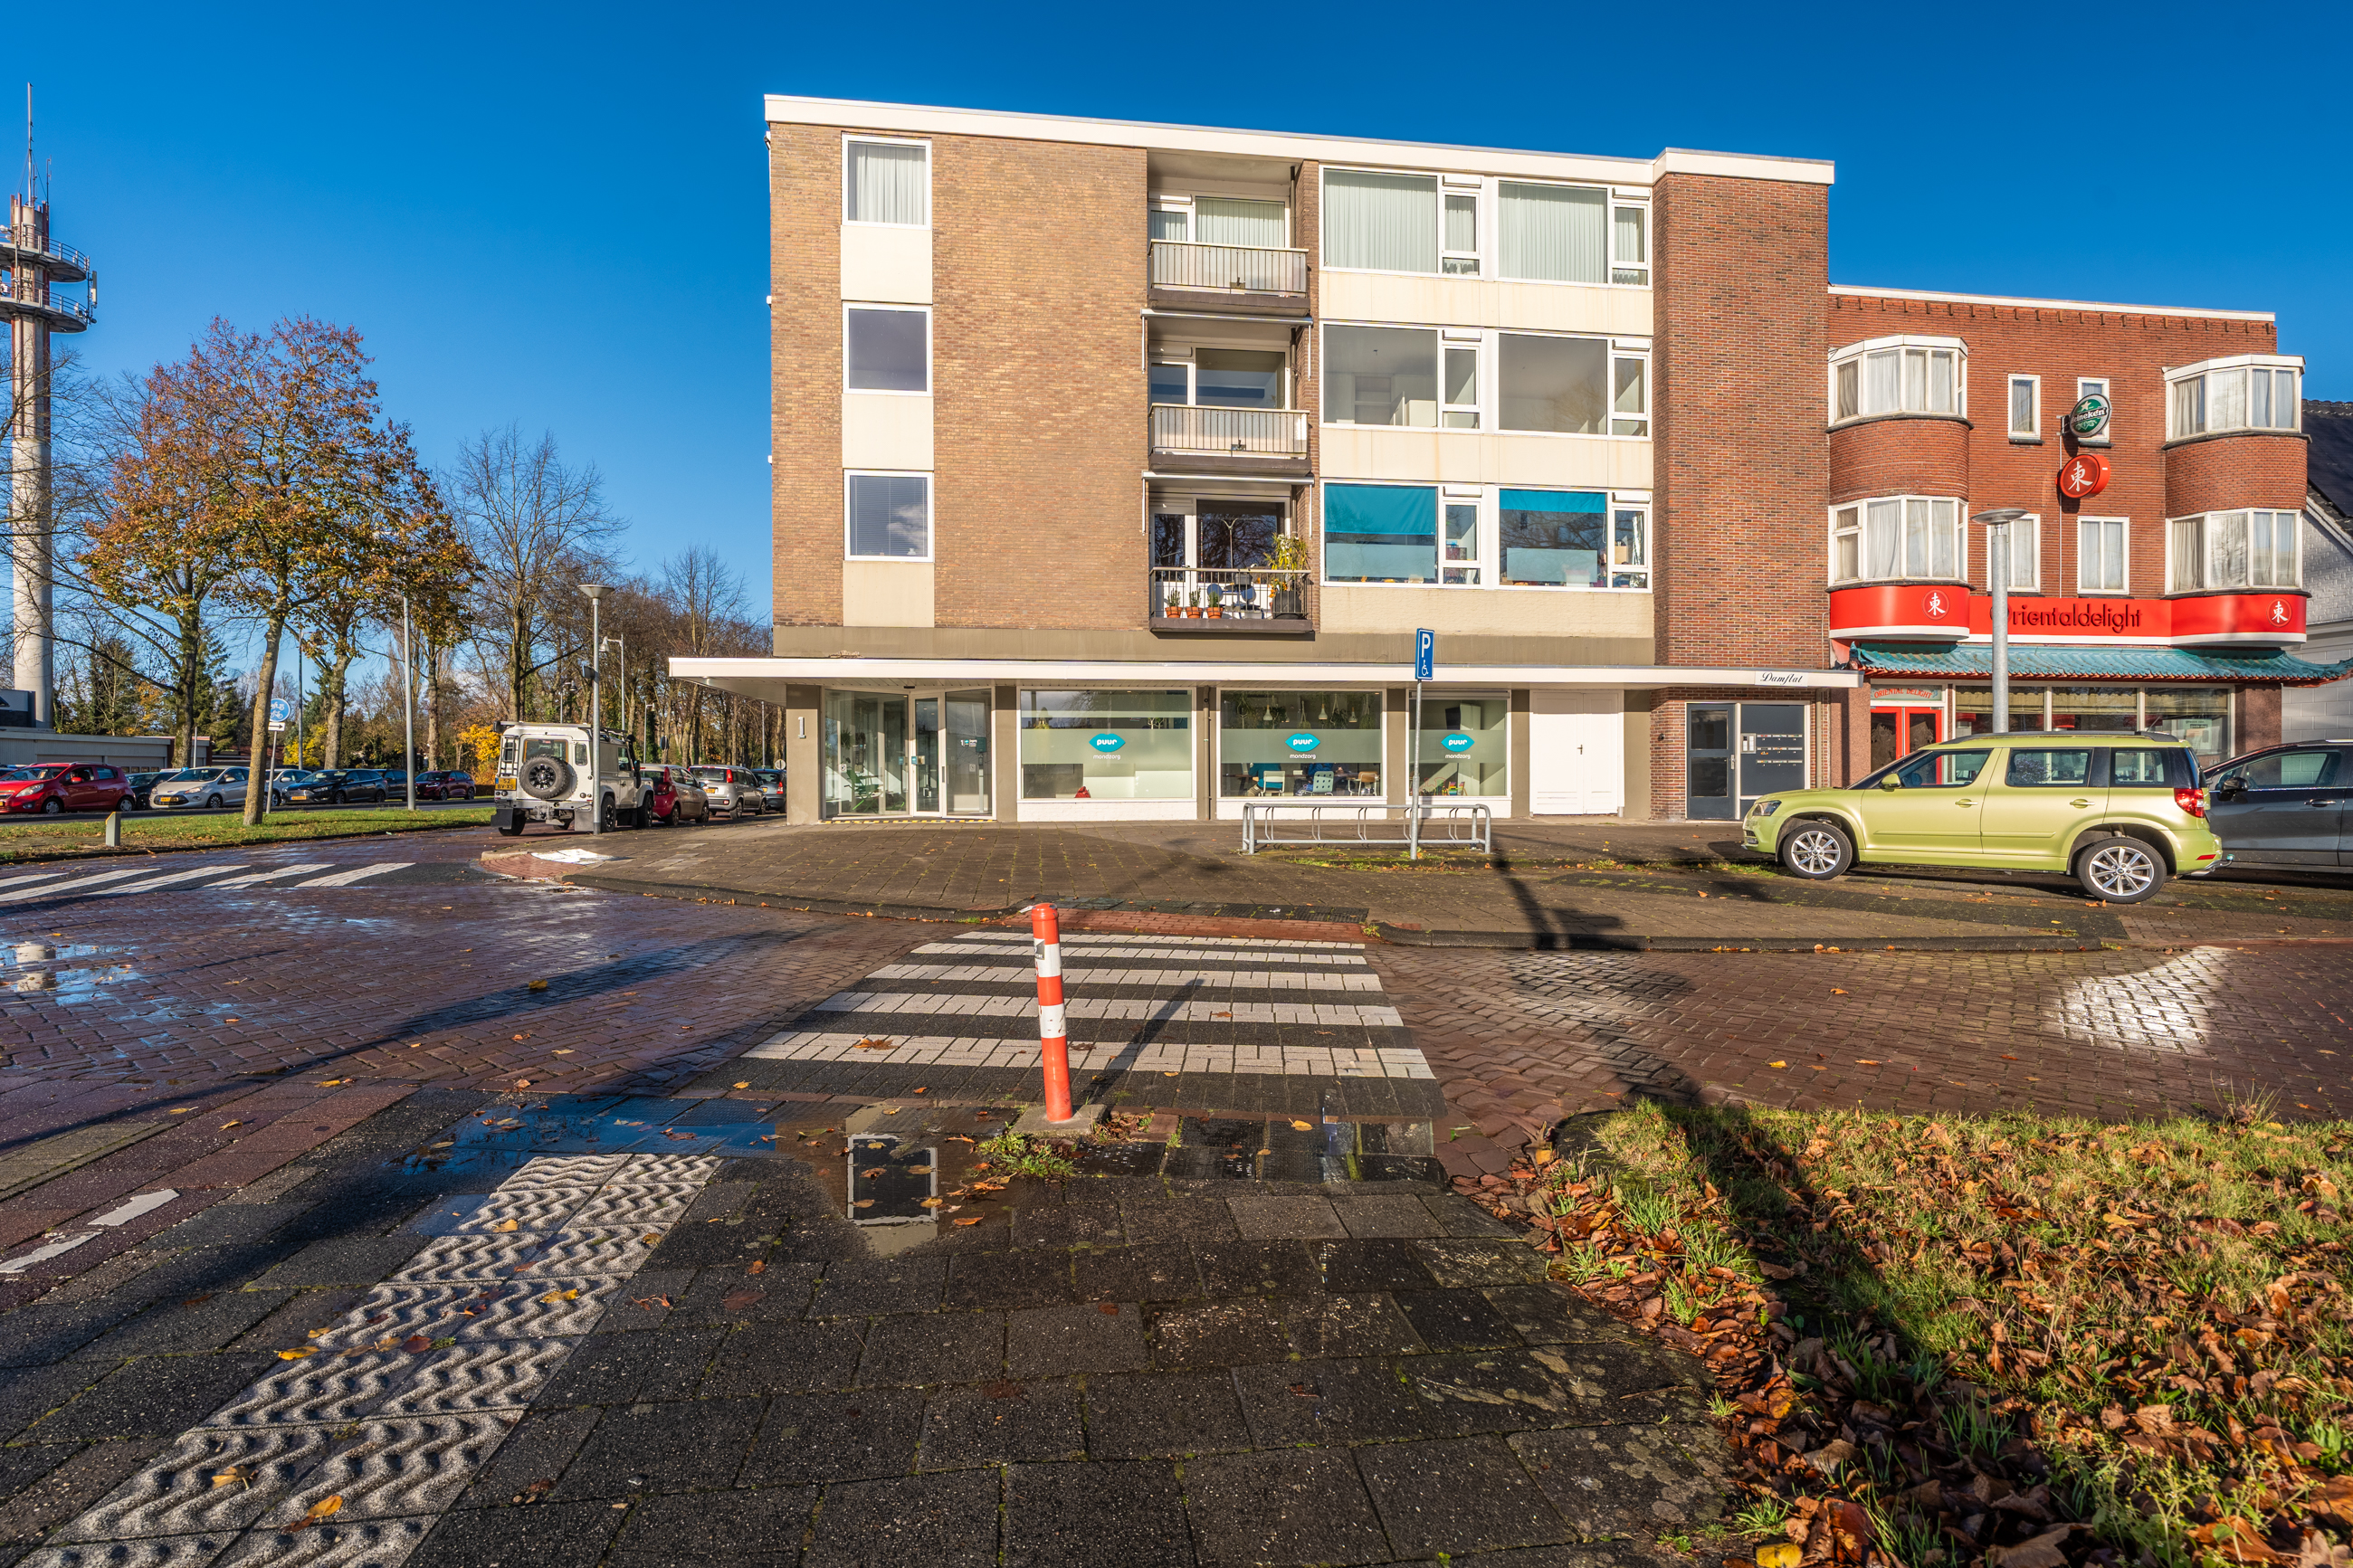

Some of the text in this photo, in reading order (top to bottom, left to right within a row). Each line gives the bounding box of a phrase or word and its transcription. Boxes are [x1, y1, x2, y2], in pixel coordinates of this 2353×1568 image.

[2072, 409, 2105, 423] eineken
[2068, 461, 2093, 492] 東
[1928, 592, 1947, 616] 東
[2272, 601, 2289, 623] 東
[1990, 603, 2142, 633] rientaldelight
[1421, 632, 1431, 658] P
[1760, 672, 1803, 685] Damflat
[1874, 688, 1932, 698] ORIENTAL DELIGHT
[797, 716, 806, 739] 1
